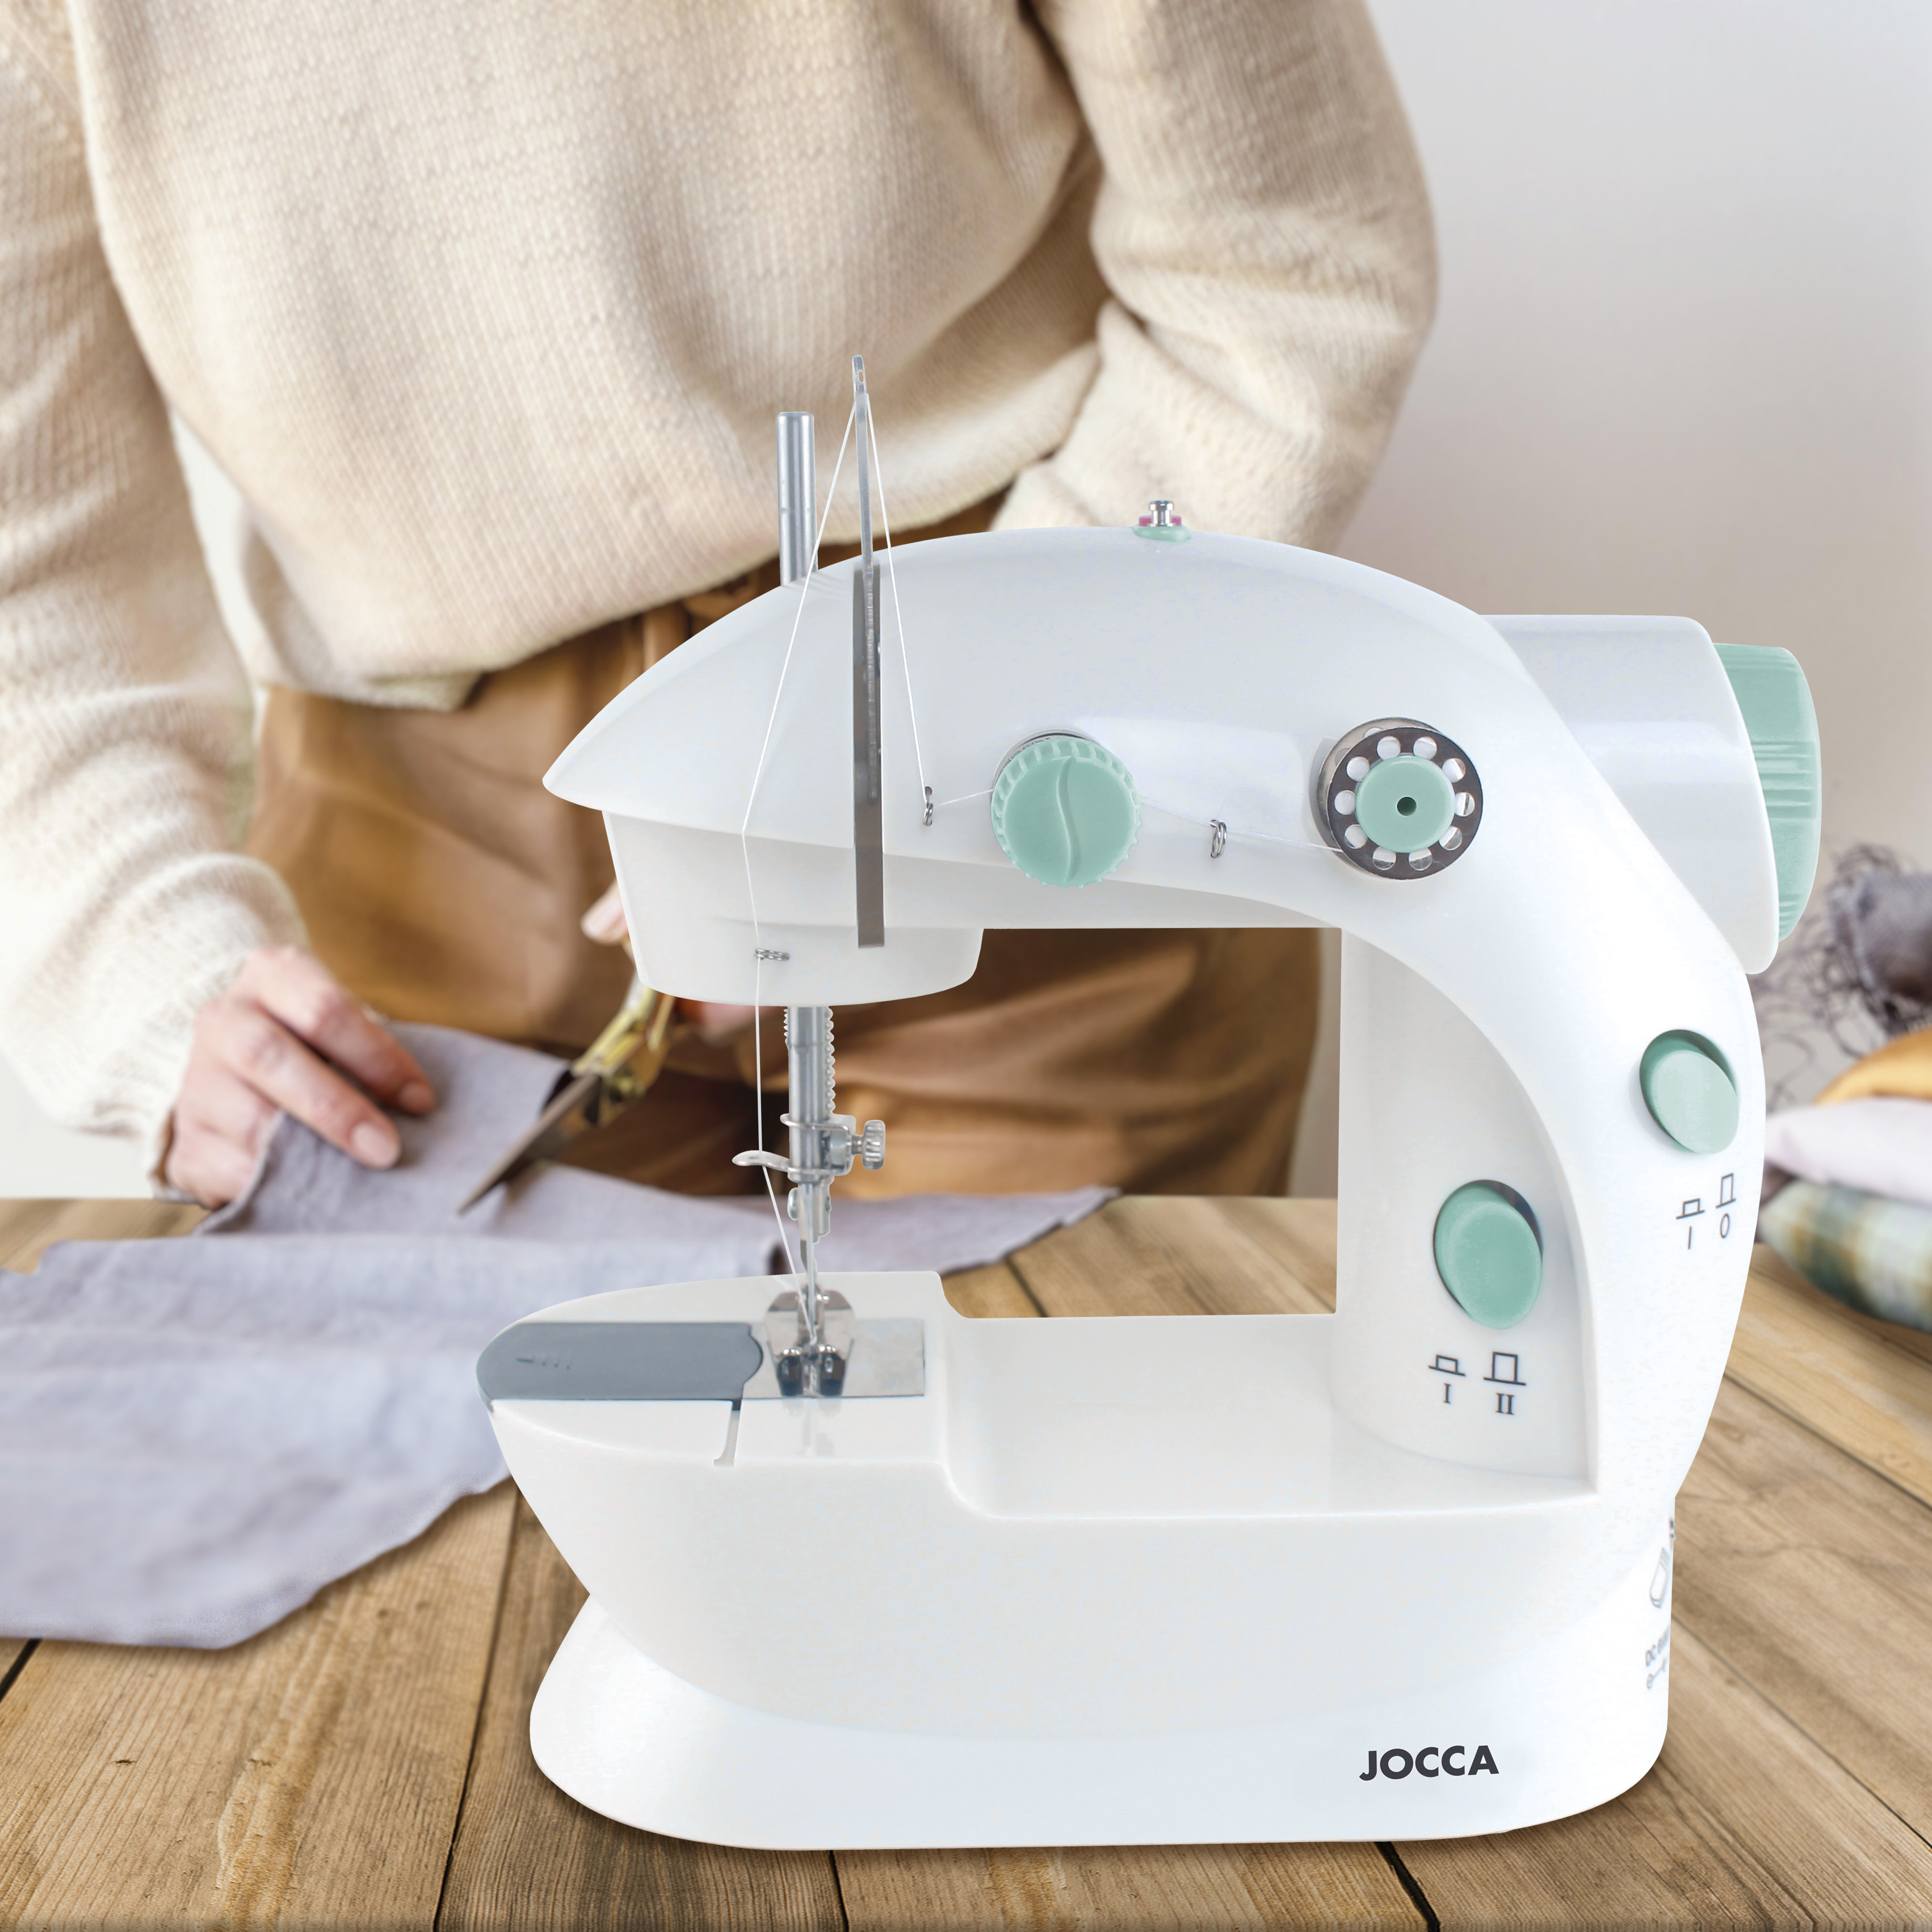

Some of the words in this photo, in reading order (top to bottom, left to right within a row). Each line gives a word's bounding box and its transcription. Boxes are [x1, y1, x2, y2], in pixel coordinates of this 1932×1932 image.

[1443, 1383, 1451, 1404] I
[1496, 1393, 1515, 1415] II
[1359, 1745, 1500, 1781] JOCCA
